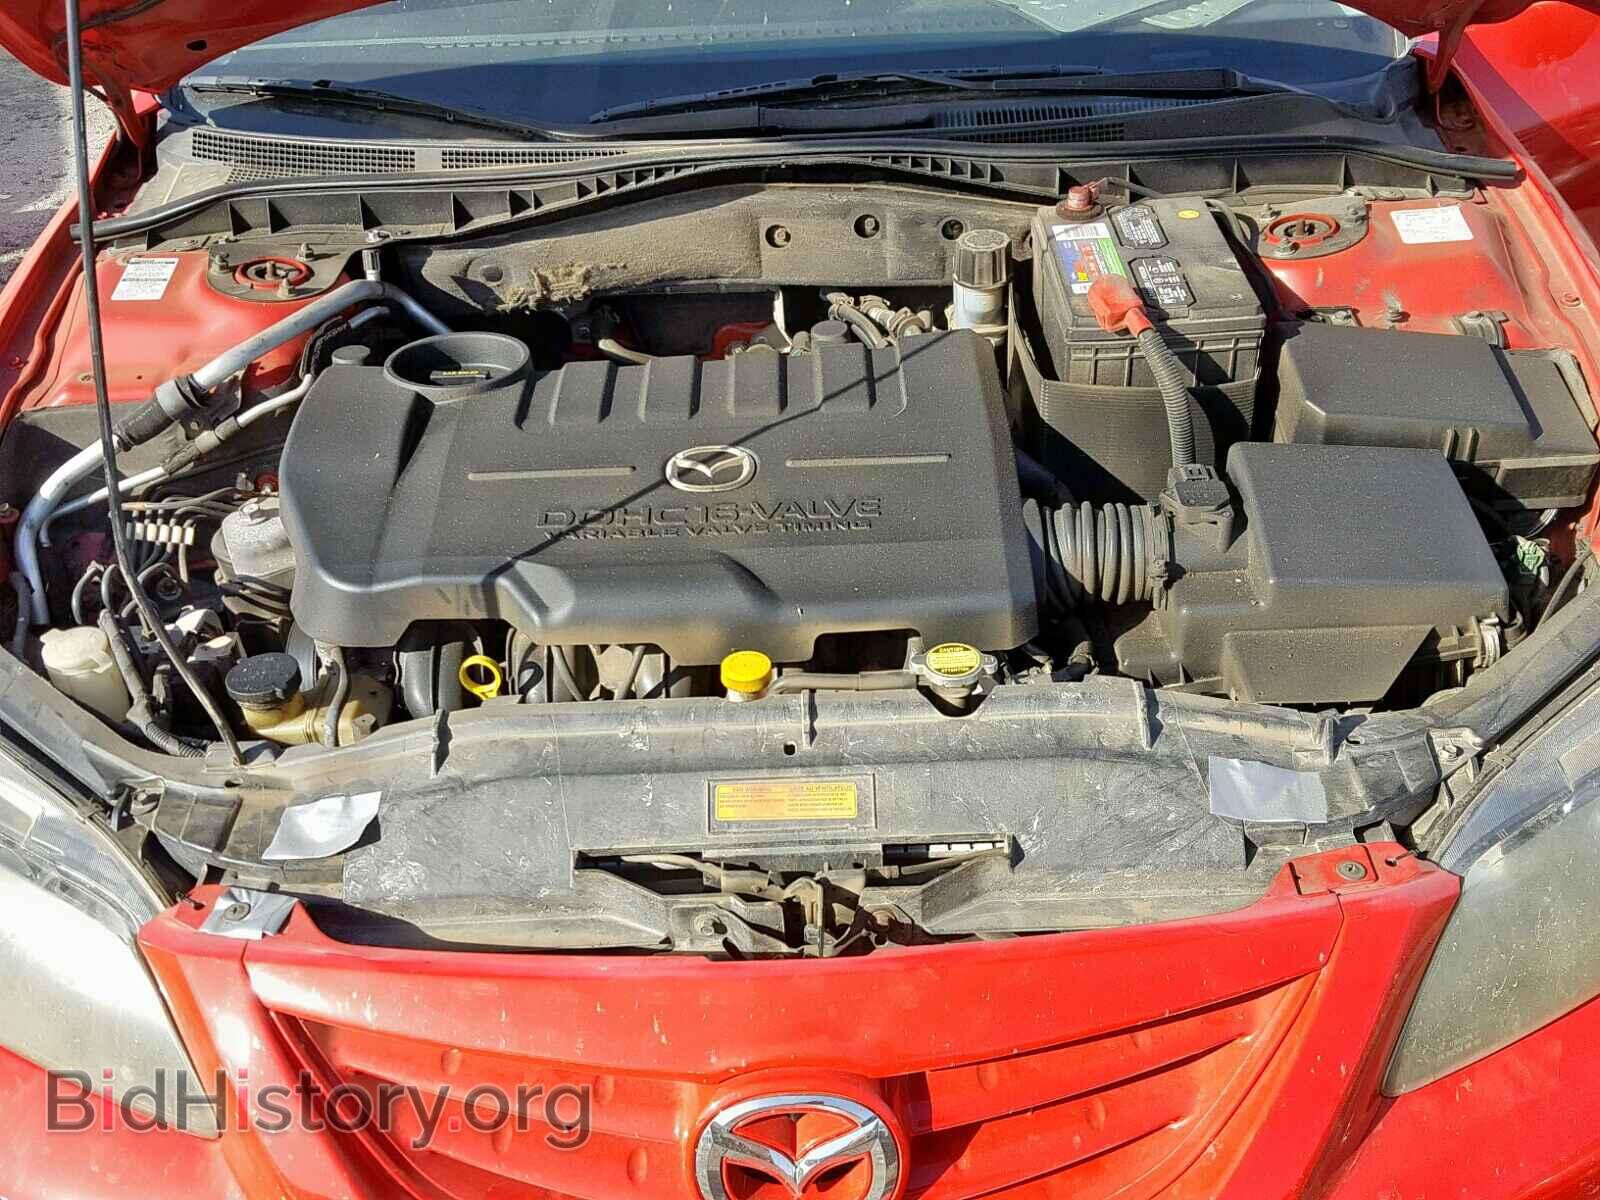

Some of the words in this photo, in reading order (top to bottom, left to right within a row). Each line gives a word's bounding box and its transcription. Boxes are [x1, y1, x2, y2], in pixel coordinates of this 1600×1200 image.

[536, 505, 690, 528] DOHC
[544, 526, 681, 540] VARIABLE
[687, 522, 770, 537] VALVE
[778, 518, 873, 536] TIMING
